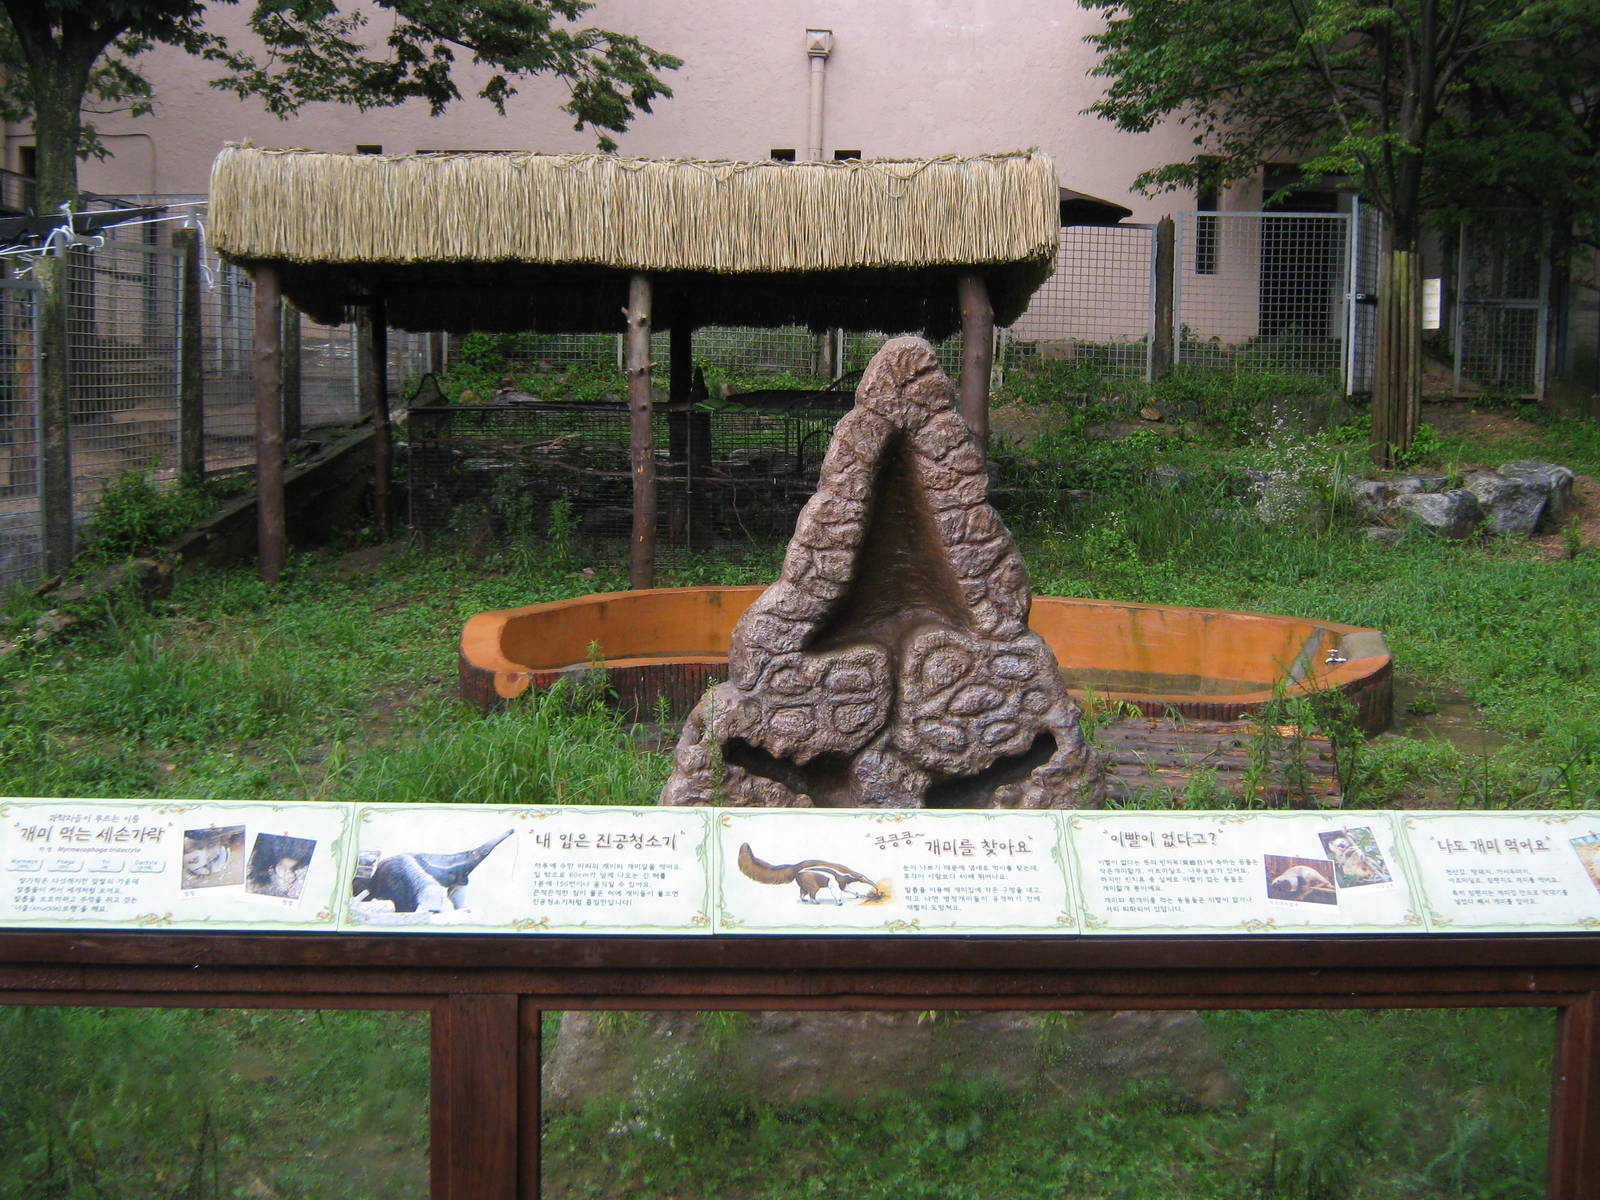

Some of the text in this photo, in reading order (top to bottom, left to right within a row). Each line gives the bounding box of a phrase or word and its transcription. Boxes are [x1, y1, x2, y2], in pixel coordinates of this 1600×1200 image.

[60, 826, 93, 843] 먹는
[559, 832, 592, 849] 입은
[925, 838, 976, 857] 개미를
[1470, 838, 1502, 855] 개미
